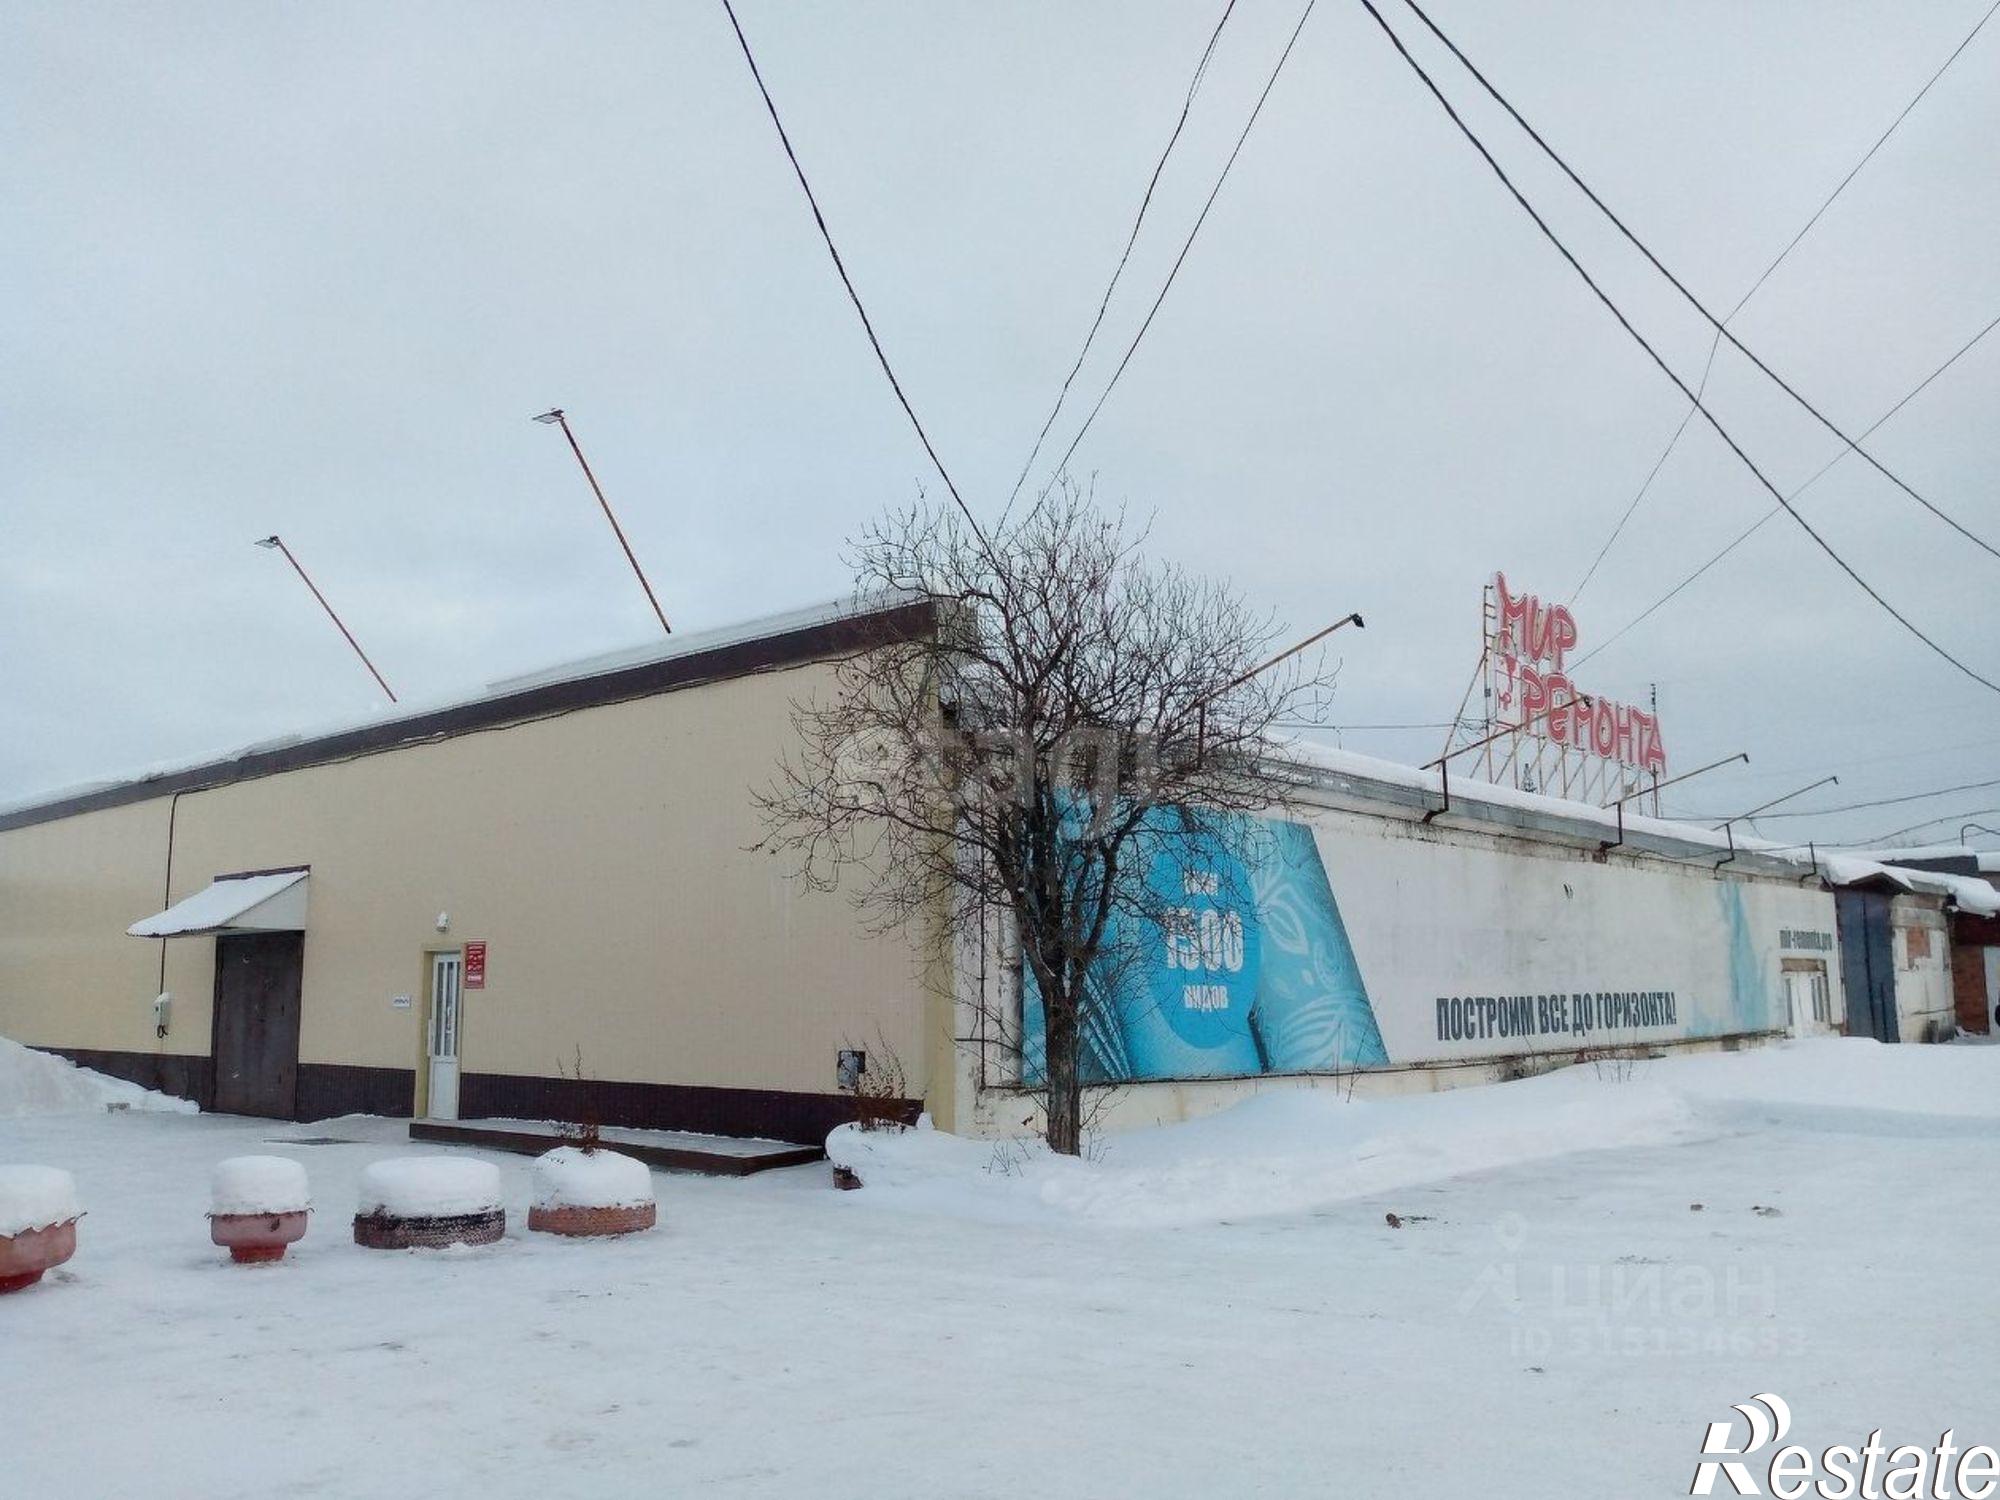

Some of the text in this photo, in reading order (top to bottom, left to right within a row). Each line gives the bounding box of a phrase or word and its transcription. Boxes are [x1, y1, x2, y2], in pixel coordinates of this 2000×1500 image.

[1496, 571, 1577, 674] МИР
[1520, 665, 1667, 777] РЕМОНТА
[1436, 991, 1677, 1041] ПОСТРОИМ ВСЕ ДО ГОРИЗОНТА!
